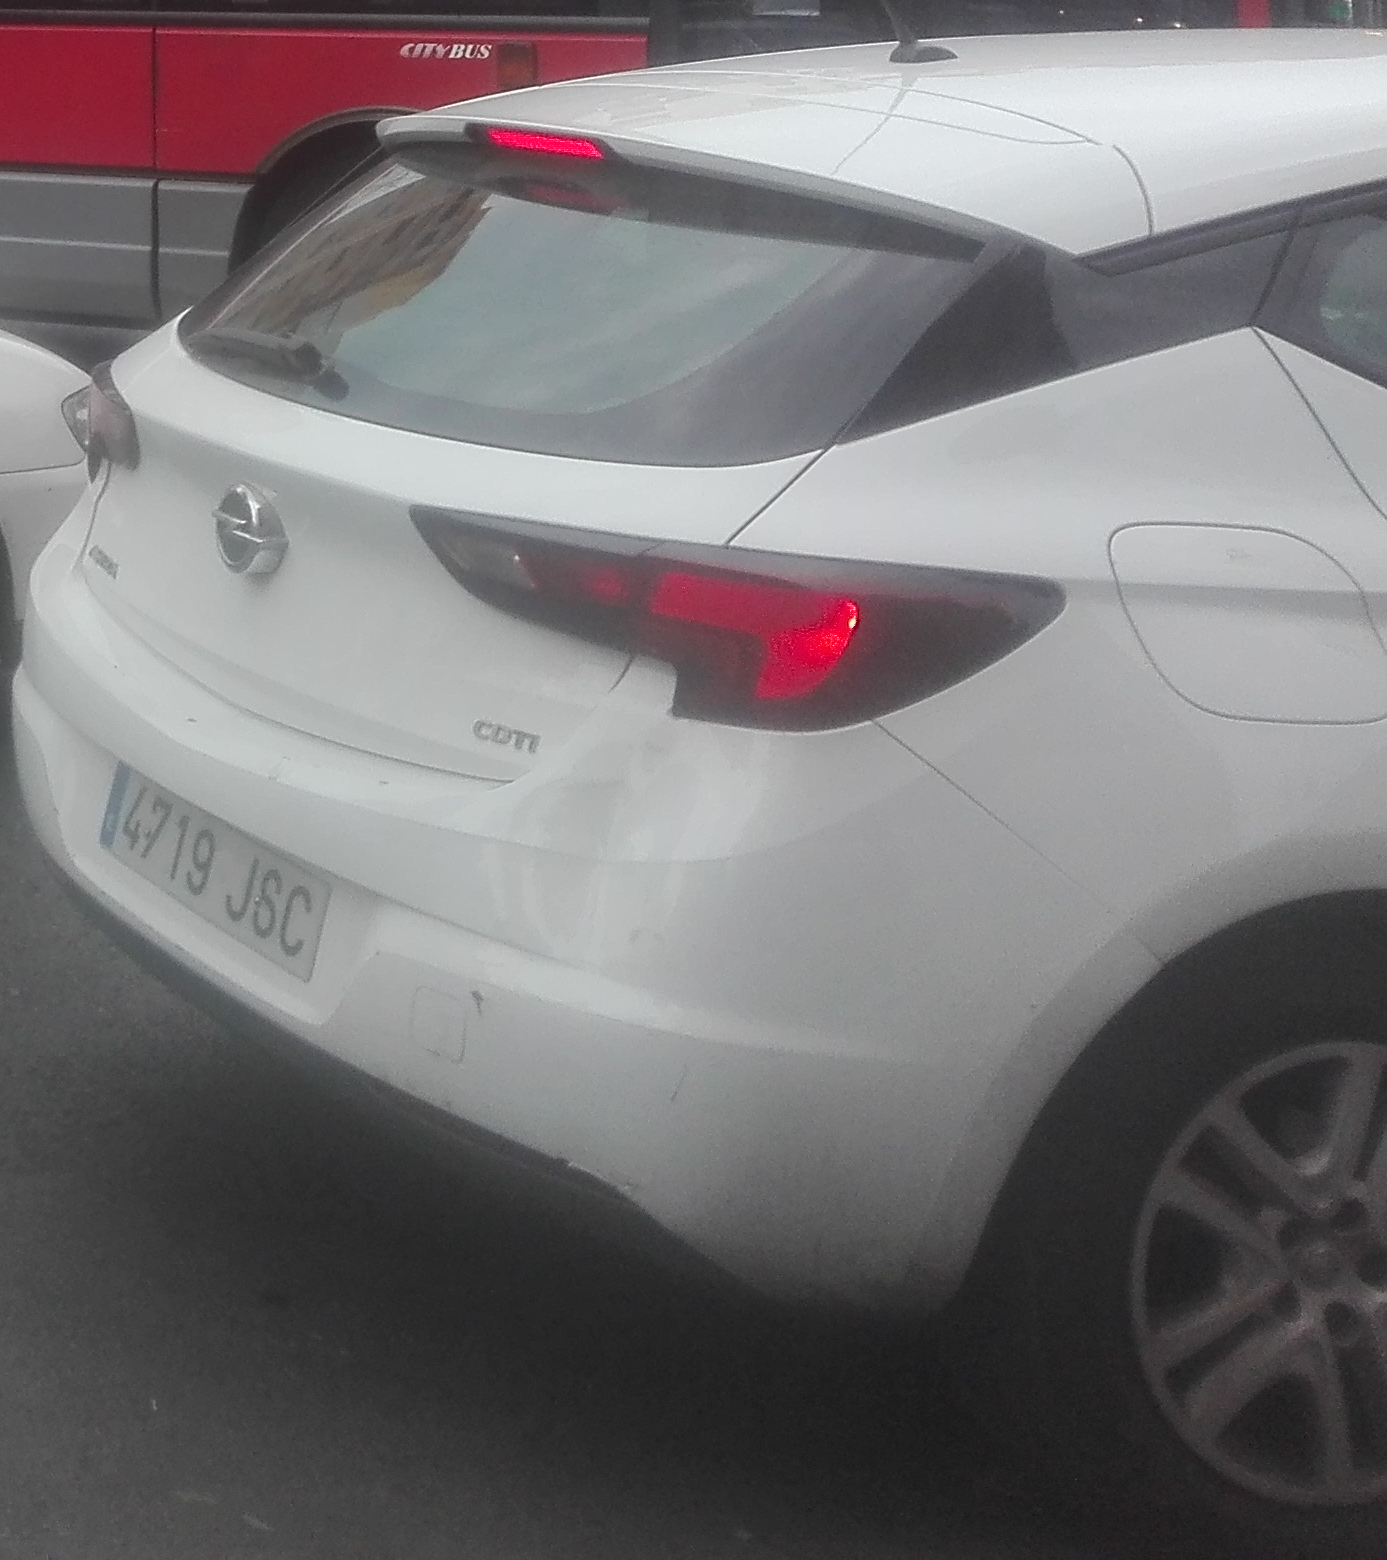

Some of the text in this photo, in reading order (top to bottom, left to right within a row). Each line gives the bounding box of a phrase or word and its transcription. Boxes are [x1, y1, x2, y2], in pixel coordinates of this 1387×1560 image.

[473, 720, 541, 754] CDTI
[122, 786, 312, 957] 4719 JSC
